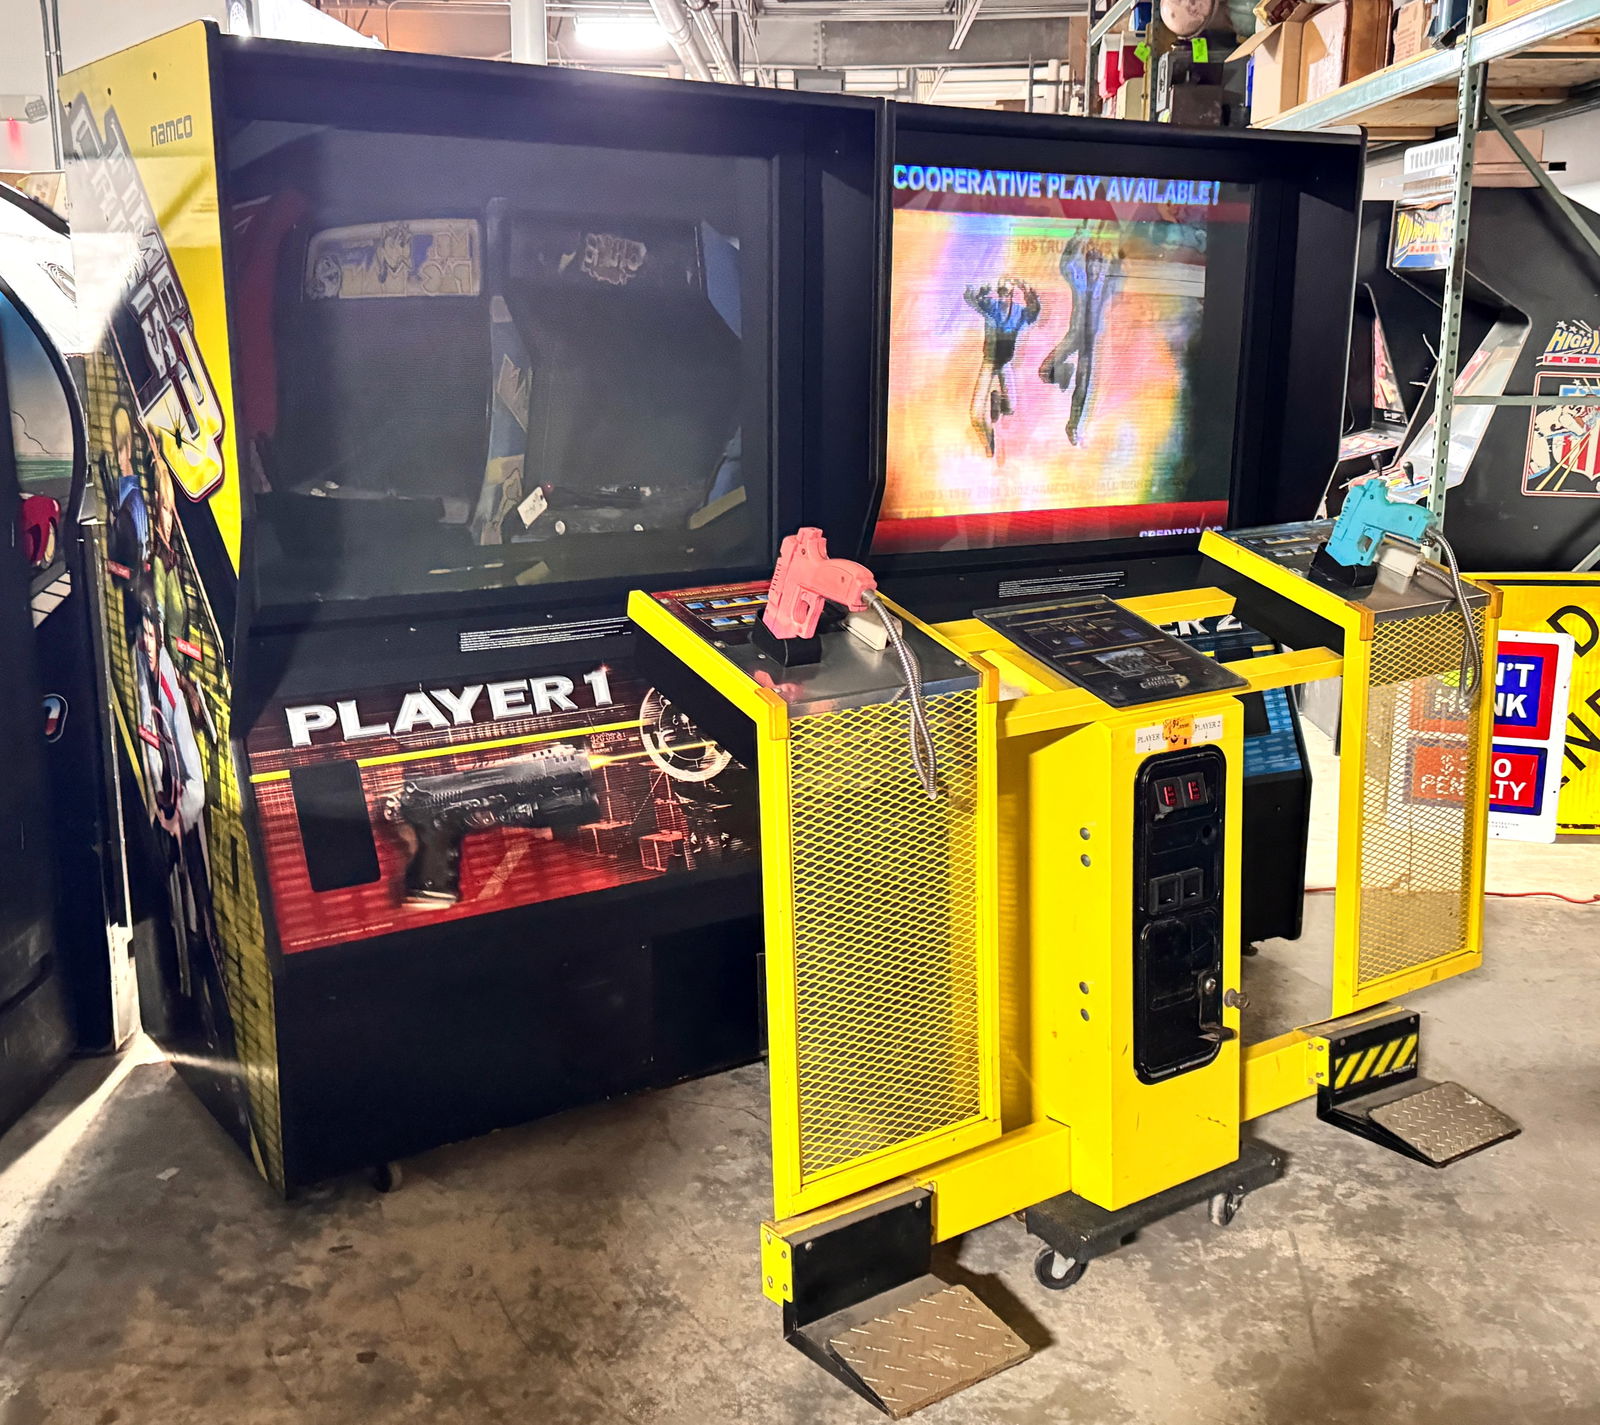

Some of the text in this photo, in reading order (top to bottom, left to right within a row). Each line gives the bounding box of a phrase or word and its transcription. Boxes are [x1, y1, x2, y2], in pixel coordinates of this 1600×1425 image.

[150, 114, 193, 147] namco
[1410, 144, 1455, 170] TELEPHONE
[893, 164, 1221, 206] COOPERATIVE PLAY AVAILABLE!
[71, 105, 177, 380] CRIIS
[1545, 328, 1592, 353] HIGH
[284, 668, 613, 748] PLAYER 1
[1137, 733, 1160, 744] PLAYER
[1195, 723, 1216, 732] PLAYER
